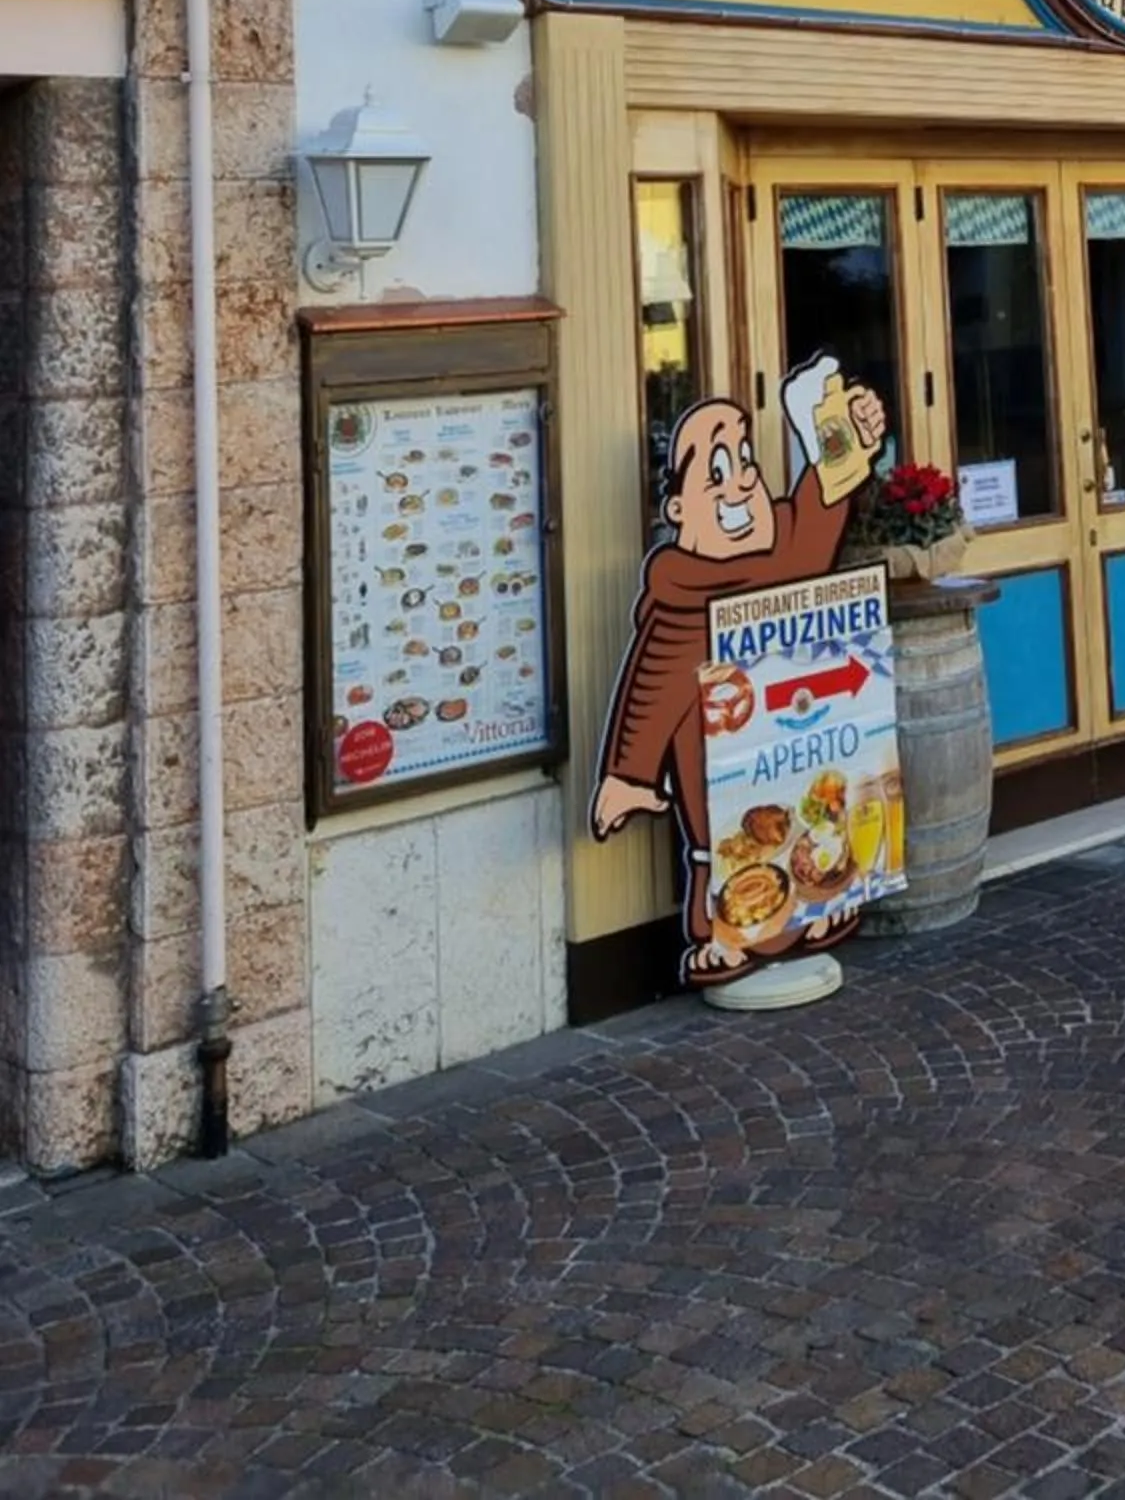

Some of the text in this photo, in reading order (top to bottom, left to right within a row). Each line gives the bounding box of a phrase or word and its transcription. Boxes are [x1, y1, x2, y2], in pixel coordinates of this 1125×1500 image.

[716, 574, 880, 628] RISTORANTE BIRRERIA
[717, 597, 882, 664] KAPUZINER
[751, 723, 860, 787] APERTO
